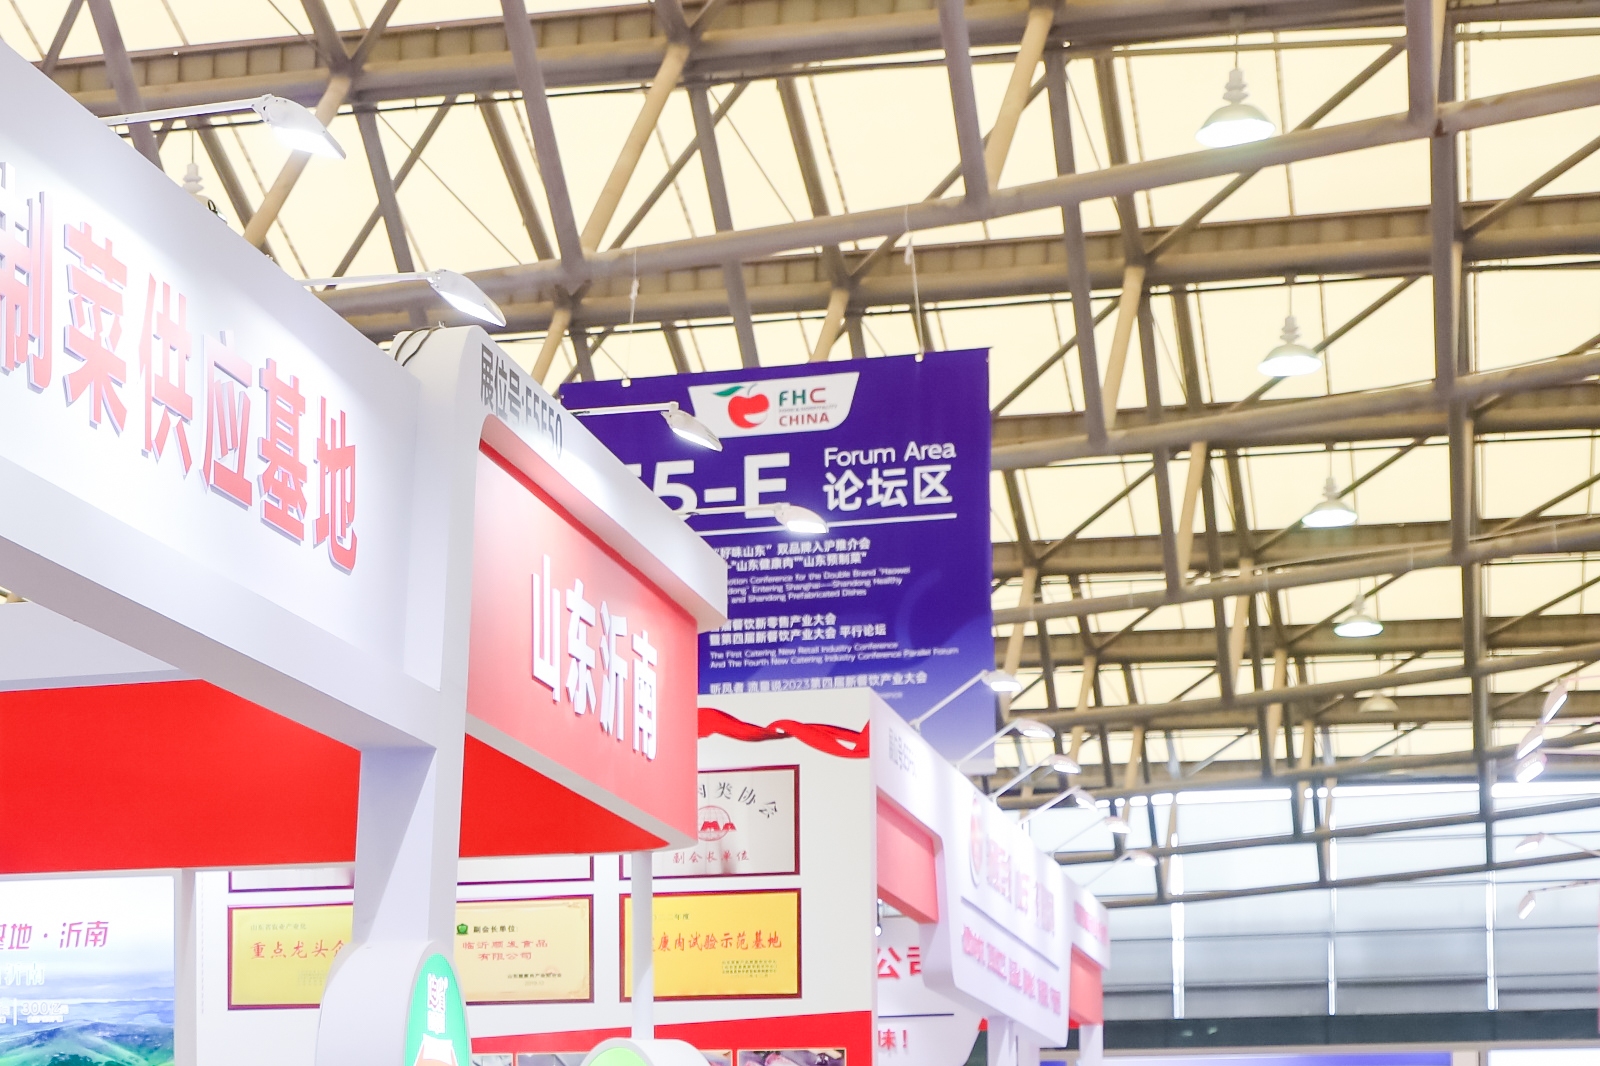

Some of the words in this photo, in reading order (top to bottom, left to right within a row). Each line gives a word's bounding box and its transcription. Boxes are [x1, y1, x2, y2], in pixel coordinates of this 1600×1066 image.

[779, 388, 827, 408] FHC
[779, 412, 830, 427] CHINA
[824, 446, 896, 468] Forum
[904, 441, 957, 461] Area
[823, 465, 952, 512] 论坛区
[750, 574, 793, 585] Conference
[824, 570, 851, 580] Double
[853, 568, 877, 578] Brand
[840, 623, 887, 638] 平行论坛
[532, 552, 658, 762] 山东沂南
[478, 952, 532, 961] 有限公司
